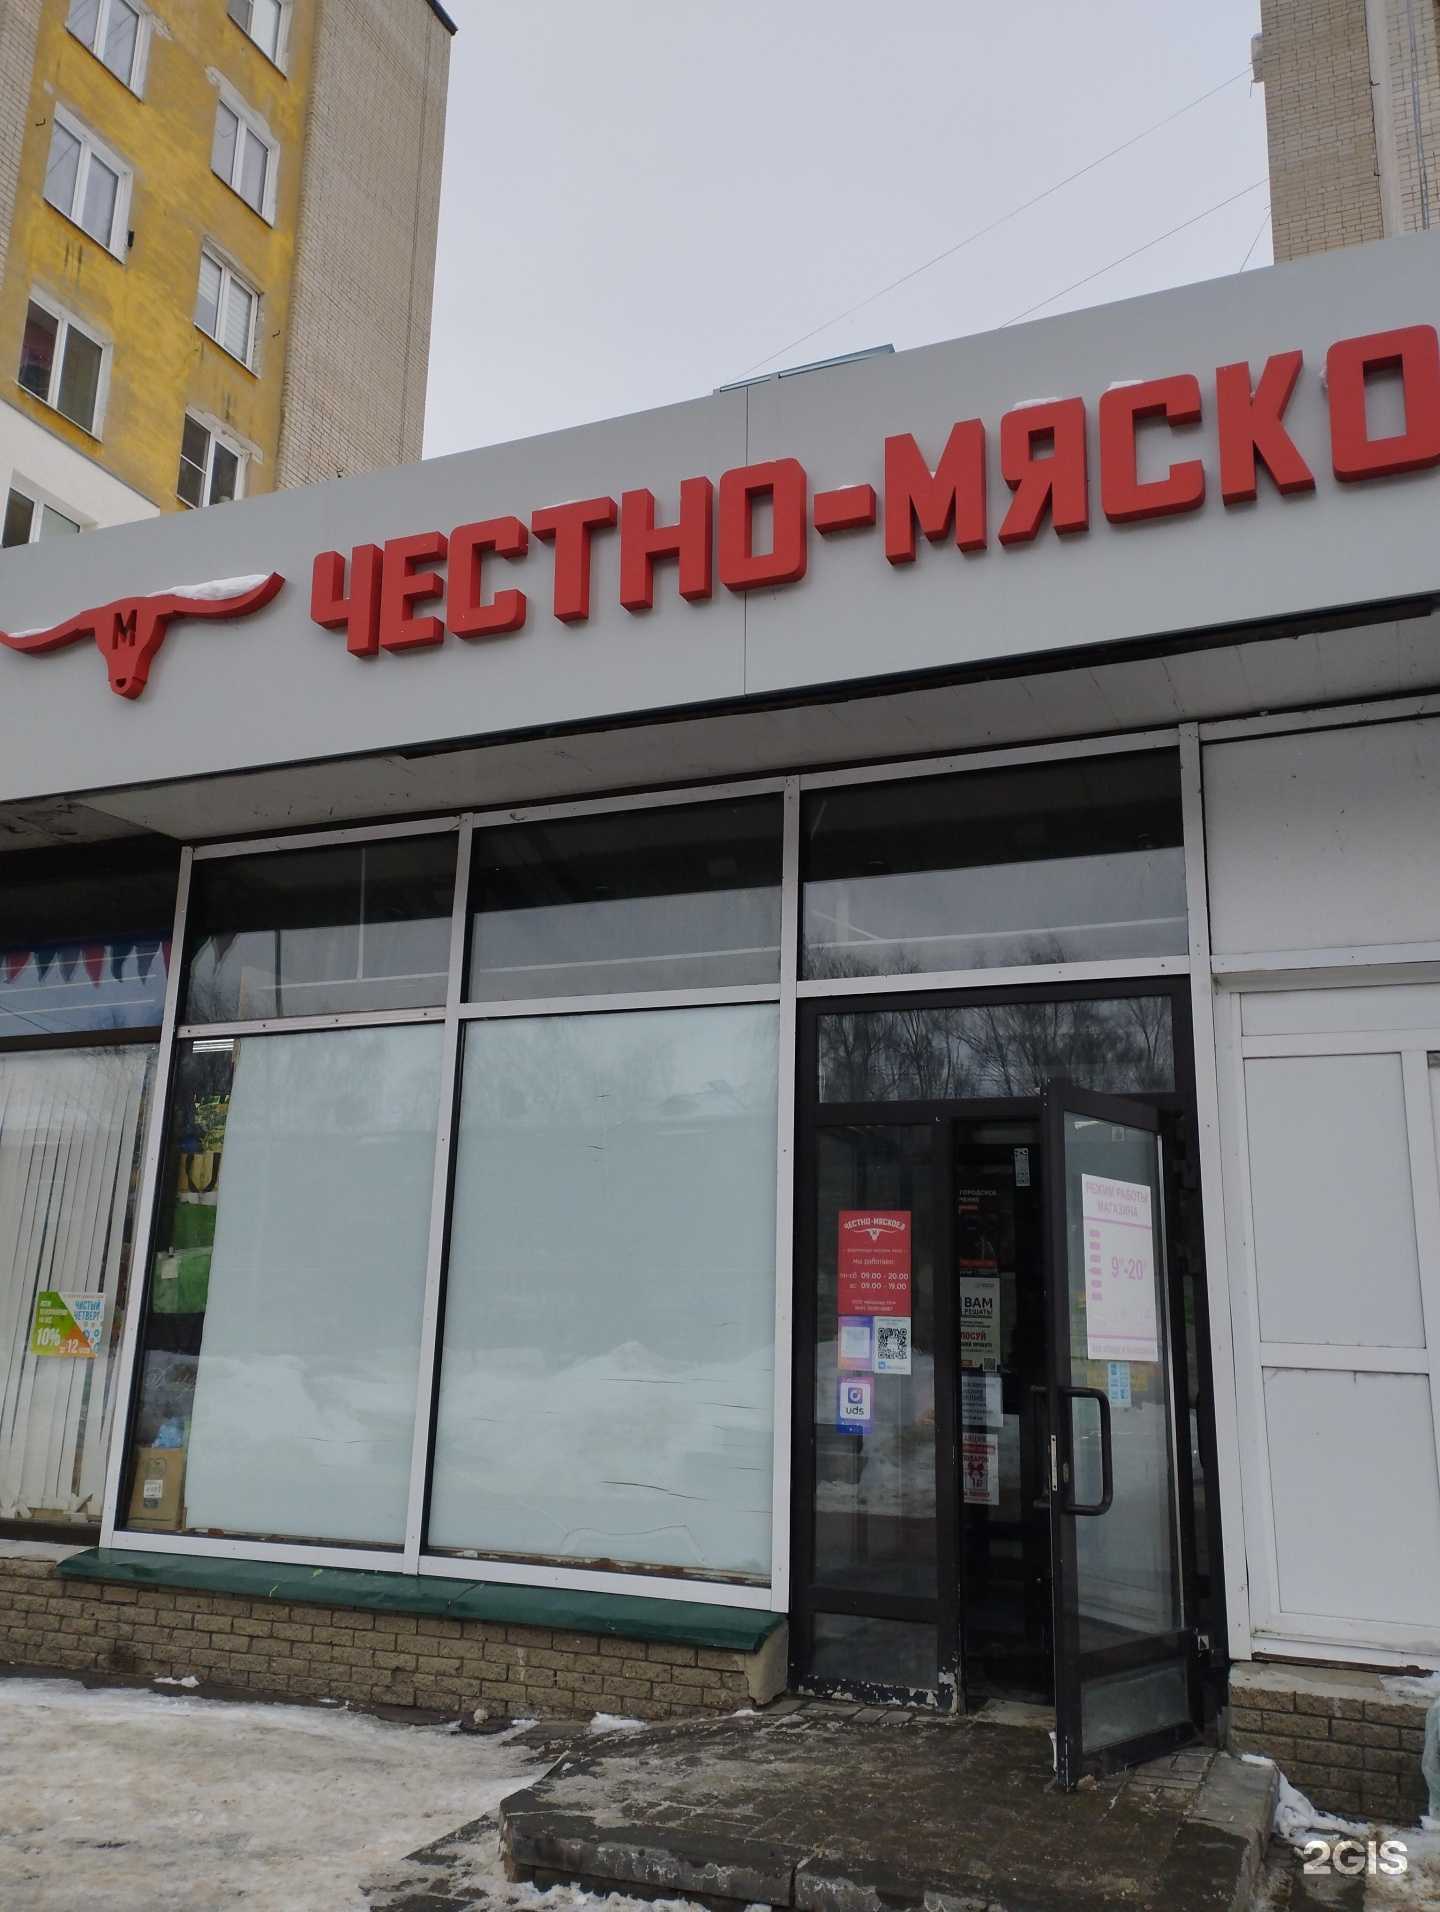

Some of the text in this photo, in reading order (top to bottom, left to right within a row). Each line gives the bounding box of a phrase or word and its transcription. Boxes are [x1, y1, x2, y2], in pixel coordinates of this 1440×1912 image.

[1115, 1186, 1149, 1204] РАБОТЫ
[1097, 1200, 1138, 1217] МАГАЗИНА
[964, 1297, 993, 1308] ВАМ
[37, 1328, 61, 1346] 10%
[845, 1405, 864, 1416] uds
